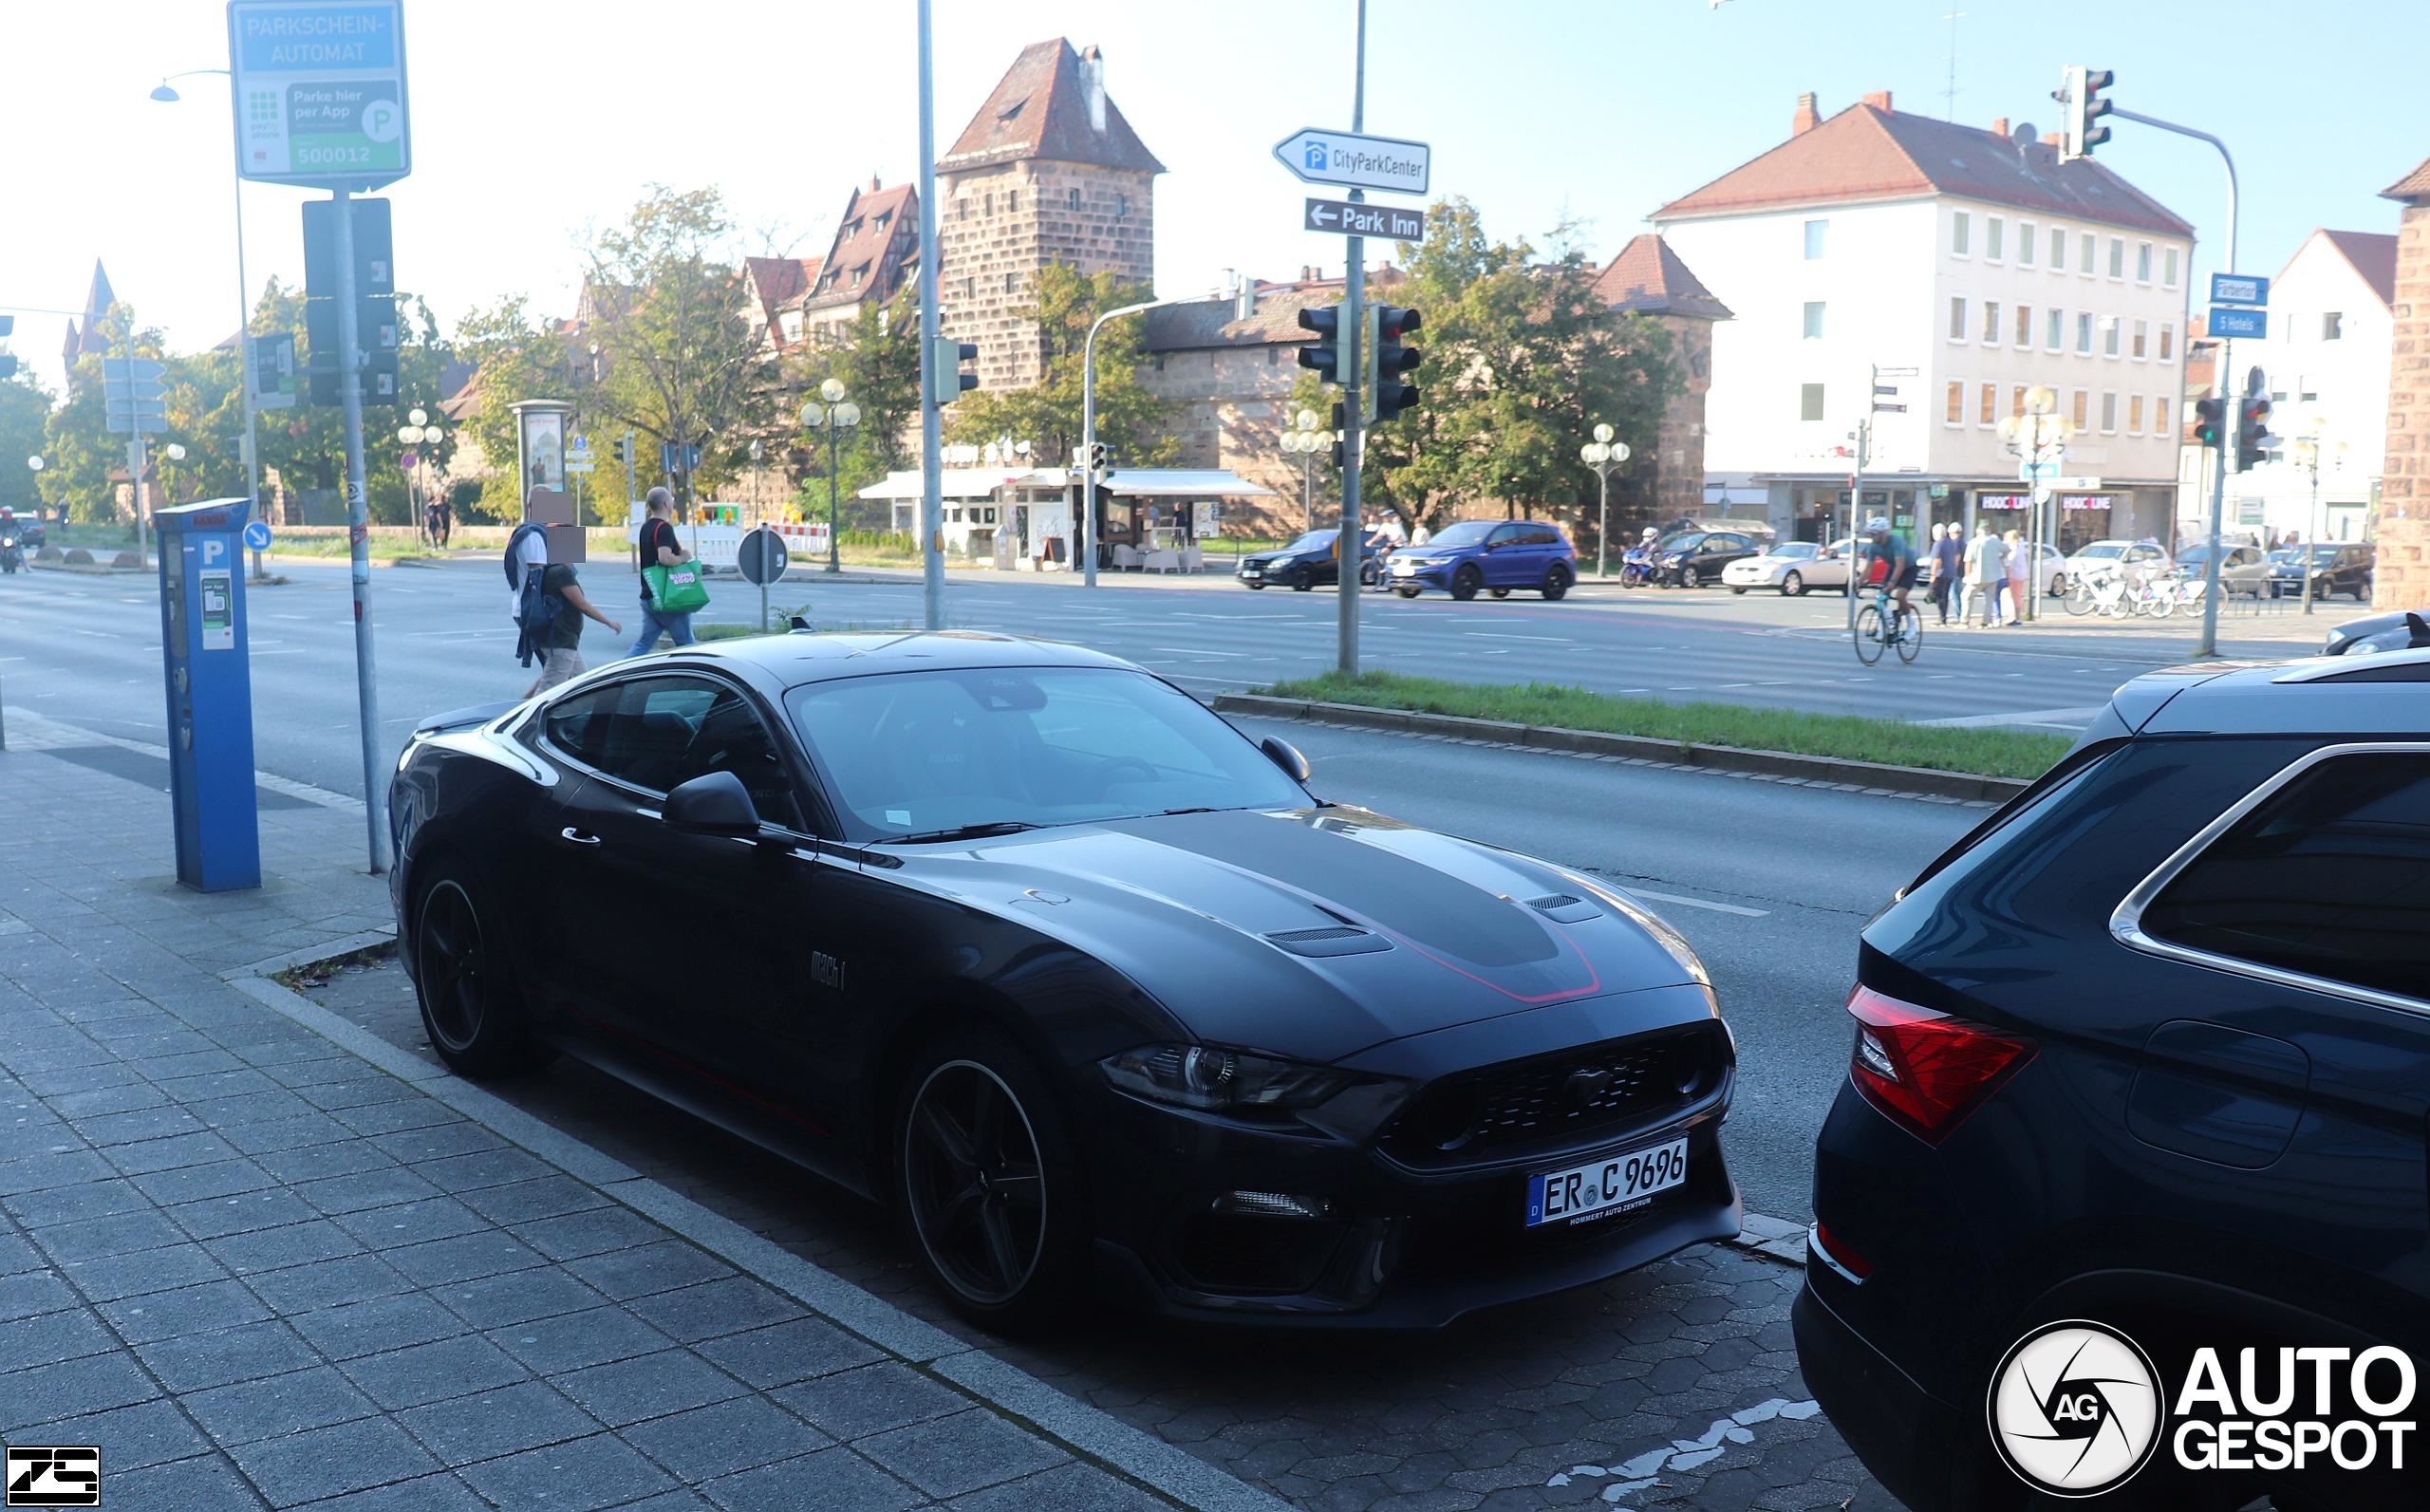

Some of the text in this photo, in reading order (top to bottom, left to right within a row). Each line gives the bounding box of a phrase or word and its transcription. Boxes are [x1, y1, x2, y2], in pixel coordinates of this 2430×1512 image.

[247, 14, 386, 37] PARKSCHEIN-
[271, 42, 366, 64] AUTOMAT
[293, 90, 363, 103] Parke hier
[295, 105, 350, 121] per App
[373, 109, 391, 133] P
[297, 147, 371, 164] 500012
[1333, 149, 1423, 178] CityParkCenter
[1342, 208, 1418, 235] Park Inn
[203, 540, 225, 565] P
[1530, 1145, 1683, 1217] D ER C 9696
[1570, 1197, 1652, 1225] HOMMERT AUTO ZENTRUM
